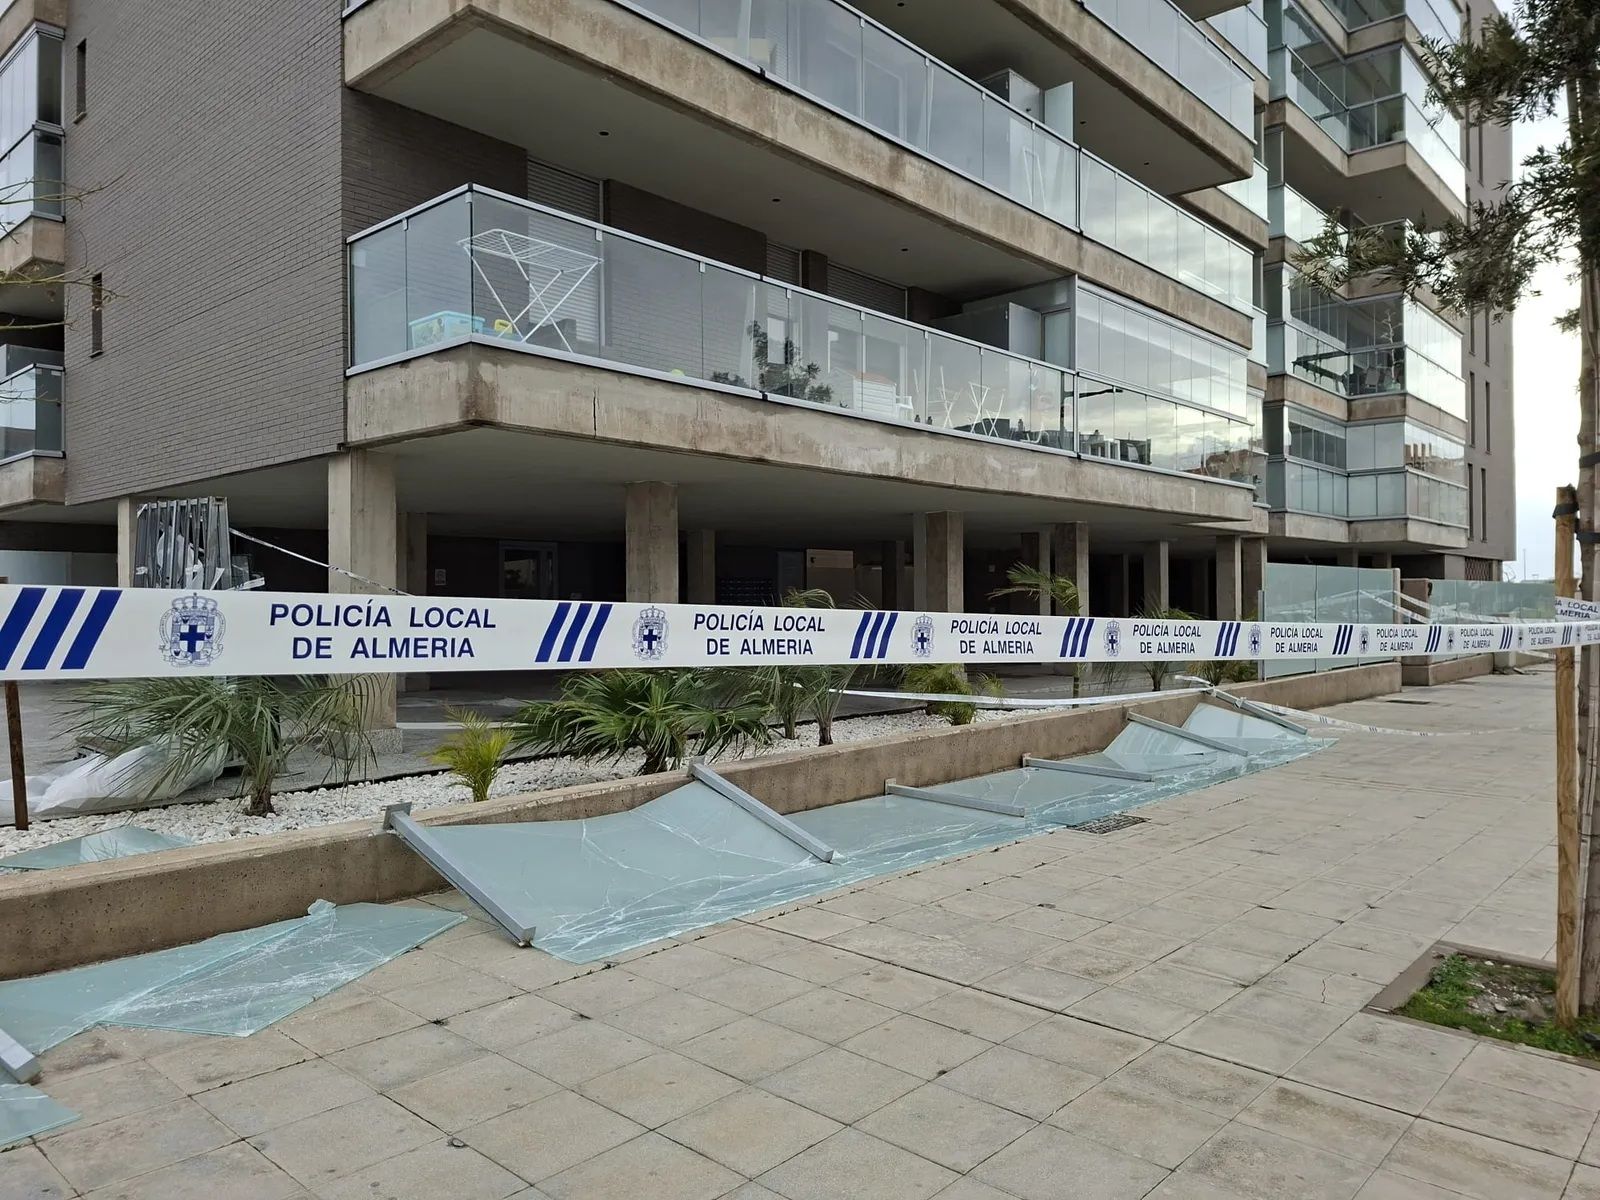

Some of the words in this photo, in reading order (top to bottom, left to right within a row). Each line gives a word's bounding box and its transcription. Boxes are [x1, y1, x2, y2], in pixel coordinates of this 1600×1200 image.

[270, 598, 392, 627] POLICÍA
[409, 606, 497, 629] LOCAL
[1567, 601, 1599, 614] LOCAL
[693, 609, 764, 631] POLICÍA
[774, 615, 826, 632] LOCAL
[950, 616, 999, 635] POLICÍA
[1006, 620, 1042, 635] LOCAL
[1132, 621, 1169, 637] POLICÍA
[1173, 625, 1202, 637] LOCAL
[1302, 628, 1324, 639] LOCAL
[1401, 628, 1419, 639] LOCAL
[292, 636, 333, 660] DE
[350, 636, 475, 659] ALMERIA
[706, 638, 730, 655] DE
[740, 638, 814, 656] ALMERIA
[959, 640, 977, 654] DE
[983, 640, 1034, 654] ALMERIA
[1140, 641, 1153, 654] DE
[1157, 641, 1196, 654] ALMERIA
[1275, 642, 1285, 653] DE
[1288, 642, 1318, 653] ALMERIA
[1380, 641, 1388, 652] DE
